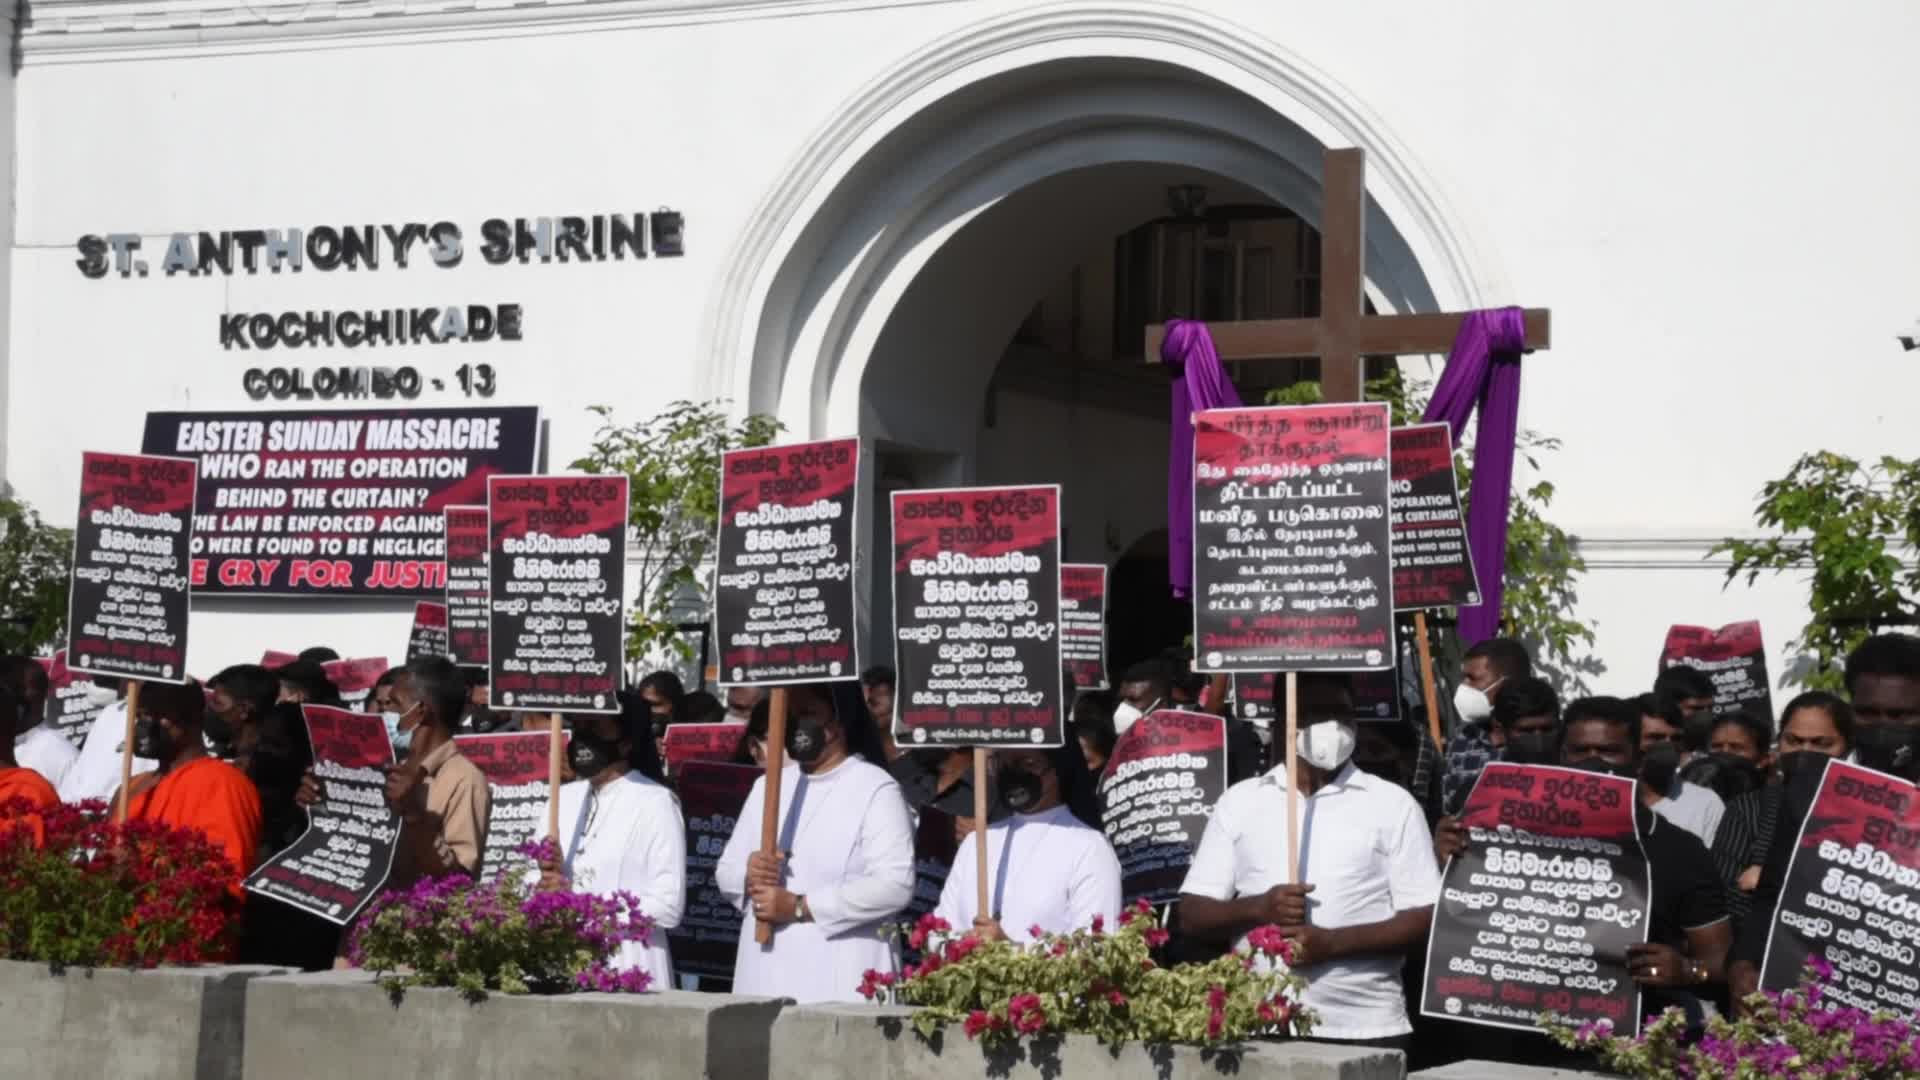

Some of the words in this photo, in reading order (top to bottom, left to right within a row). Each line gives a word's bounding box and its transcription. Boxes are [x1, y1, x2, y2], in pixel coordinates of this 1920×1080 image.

[76, 233, 148, 279] ST.
[162, 221, 463, 276] ANTHONY'S
[480, 212, 685, 265] SHRINE
[219, 304, 523, 350] KOCHCHIKADE
[243, 366, 421, 400] COLOMBO
[431, 377, 445, 391] -
[456, 364, 496, 396] 13
[177, 421, 263, 452] EASTER
[267, 420, 364, 451] SUNDAY
[365, 418, 502, 451] MASSACRE
[200, 454, 260, 479] WHO
[264, 459, 307, 479] RAN
[310, 459, 346, 478] THE
[351, 458, 468, 478] OPERATION
[215, 488, 287, 508] BEHIND
[291, 488, 327, 508] THE
[331, 488, 428, 508] CURTAIN?
[1220, 478, 1362, 503] திட்டமிடப்பட்ட
[1391, 480, 1412, 493] HO
[973, 493, 1048, 523] ඉරුදින
[1391, 495, 1452, 508] OPERATION
[222, 516, 258, 532] LAW
[262, 516, 284, 532] BE
[287, 516, 375, 532] ENFORCED
[379, 515, 444, 532] AGAINS
[1199, 505, 1257, 526] மனித
[1268, 504, 1384, 526] படுகொலை
[208, 538, 252, 554] WERE
[257, 538, 314, 554] FOUND
[319, 538, 341, 554] TO
[346, 538, 368, 554] BE
[373, 538, 444, 555] NEGLIGE
[219, 559, 279, 587] CRY
[289, 560, 353, 587] FOR
[366, 561, 447, 588] JUSTI
[910, 551, 1041, 576] සංවිධානාත්මක
[946, 623, 1008, 639] සම්බන්ධ
[991, 645, 1015, 657] සහ
[1545, 776, 1620, 810] ඉරුදින
[1503, 895, 1580, 918] සම්බන්ධ
[1488, 913, 1548, 934] ඔවුන්ට
[1554, 923, 1586, 938] සහ
[1837, 928, 1915, 964] සම්බන්ධ
[1825, 945, 1881, 978] ඔවුන්ට
[1886, 970, 1919, 991] සහ
